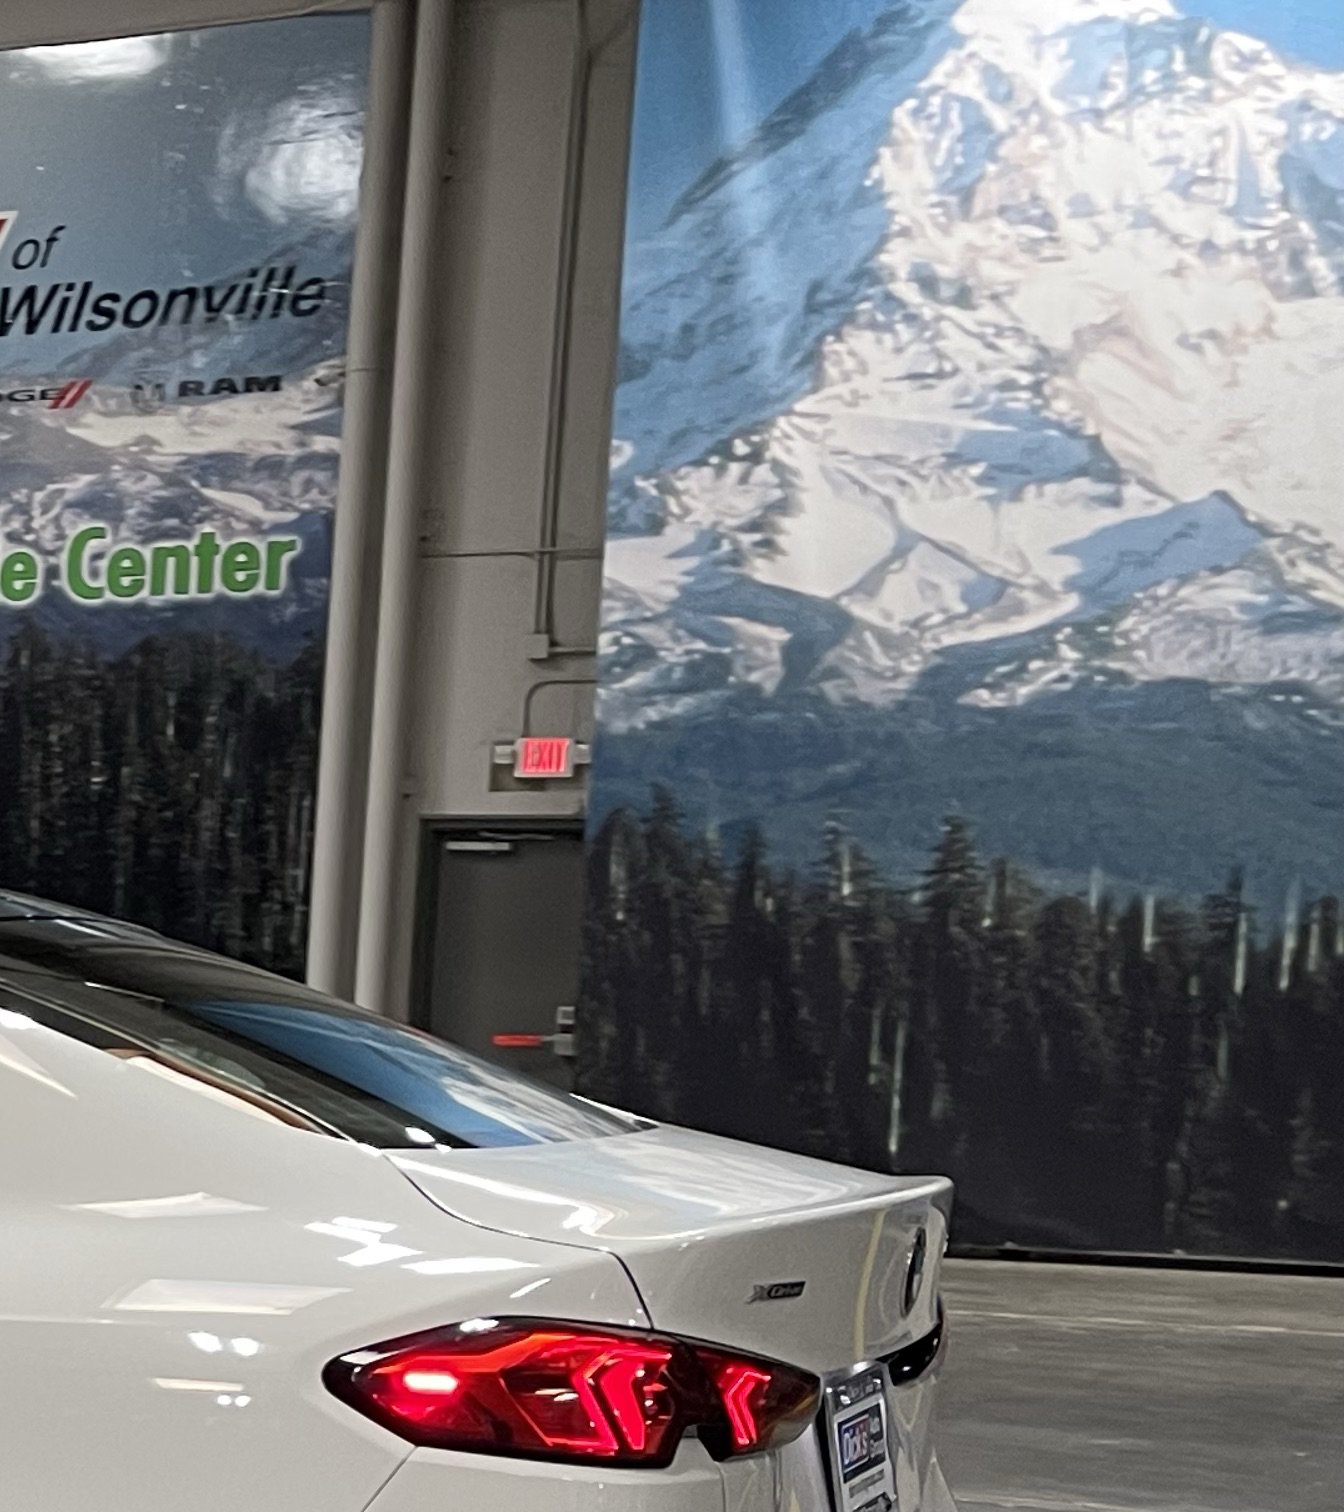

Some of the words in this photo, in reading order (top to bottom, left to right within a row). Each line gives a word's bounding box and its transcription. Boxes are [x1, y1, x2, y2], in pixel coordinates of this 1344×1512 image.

[13, 226, 66, 270] of
[178, 375, 282, 398] RAM
[67, 526, 297, 600] Center
[523, 740, 568, 772] EXIT
